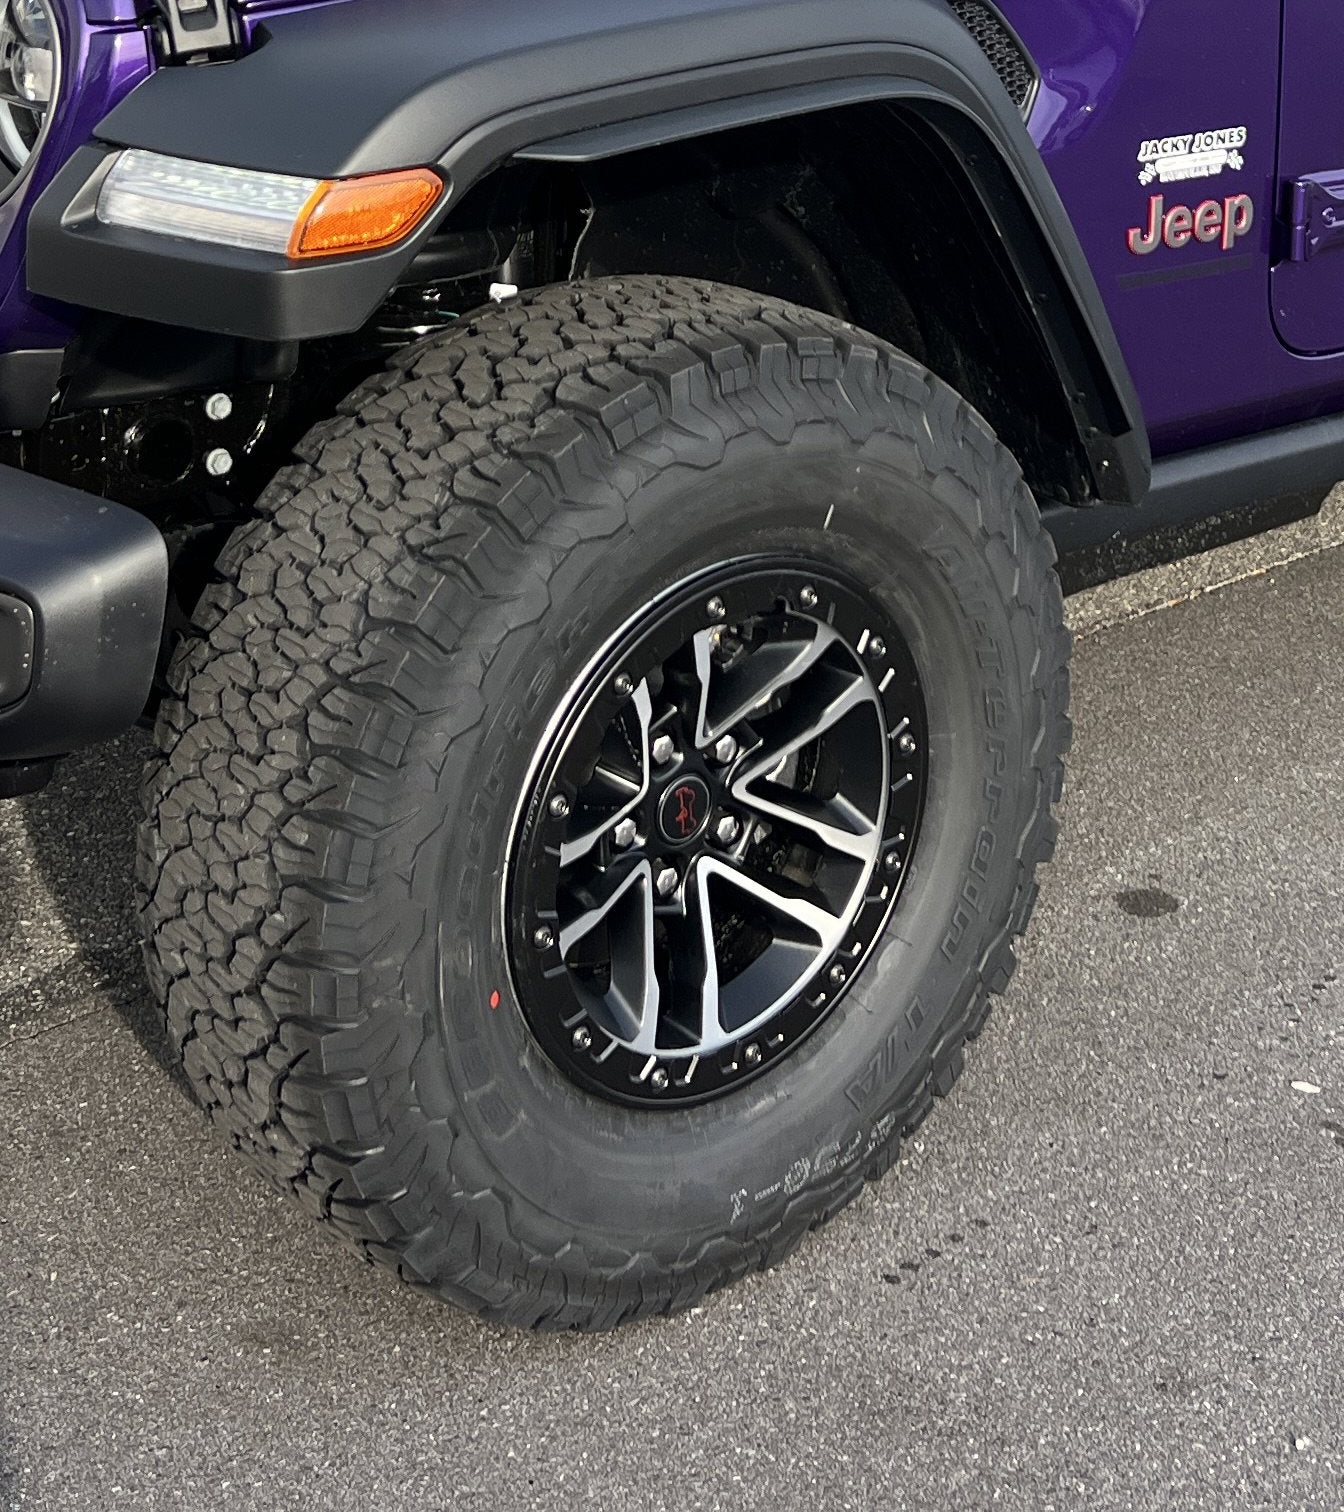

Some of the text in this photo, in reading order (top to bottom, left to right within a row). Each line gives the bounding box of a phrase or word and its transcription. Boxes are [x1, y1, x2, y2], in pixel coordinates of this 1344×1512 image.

[1140, 129, 1244, 157] JACKY JONES
[1128, 194, 1254, 255] Jeep
